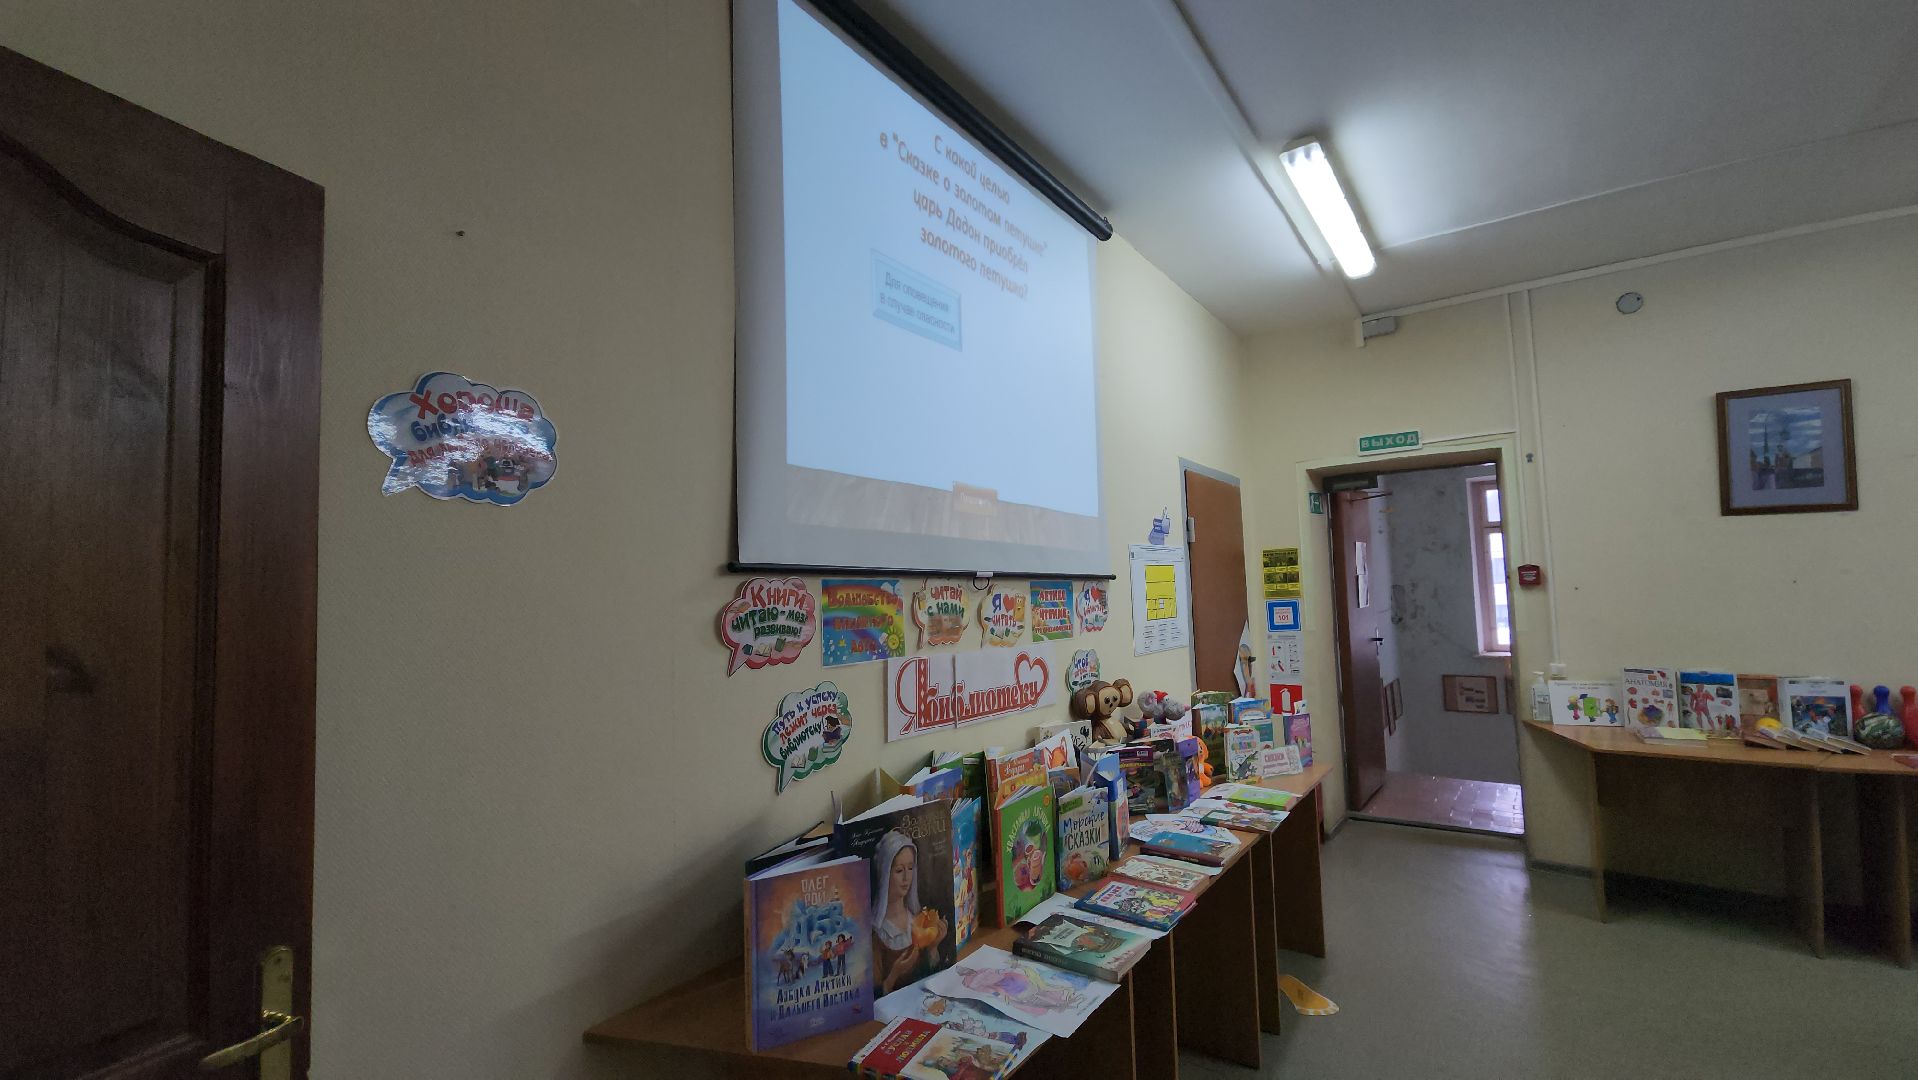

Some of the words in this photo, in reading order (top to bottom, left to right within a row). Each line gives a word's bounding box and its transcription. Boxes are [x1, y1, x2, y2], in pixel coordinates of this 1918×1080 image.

[879, 132, 888, 149] в
[943, 176, 951, 192] о
[954, 184, 1001, 226] золотом
[934, 135, 943, 154] С
[946, 144, 977, 180] какой
[979, 169, 1011, 205] целью
[913, 188, 943, 220] царь
[946, 206, 981, 242] Дадон
[920, 226, 977, 272] золотого
[1361, 432, 1418, 448] ВЫХОД
[991, 593, 1002, 613] Я
[1063, 810, 1105, 834] Морские
[1067, 826, 1101, 851] СКАЗКИ
[801, 875, 831, 893] ОЛЕГ
